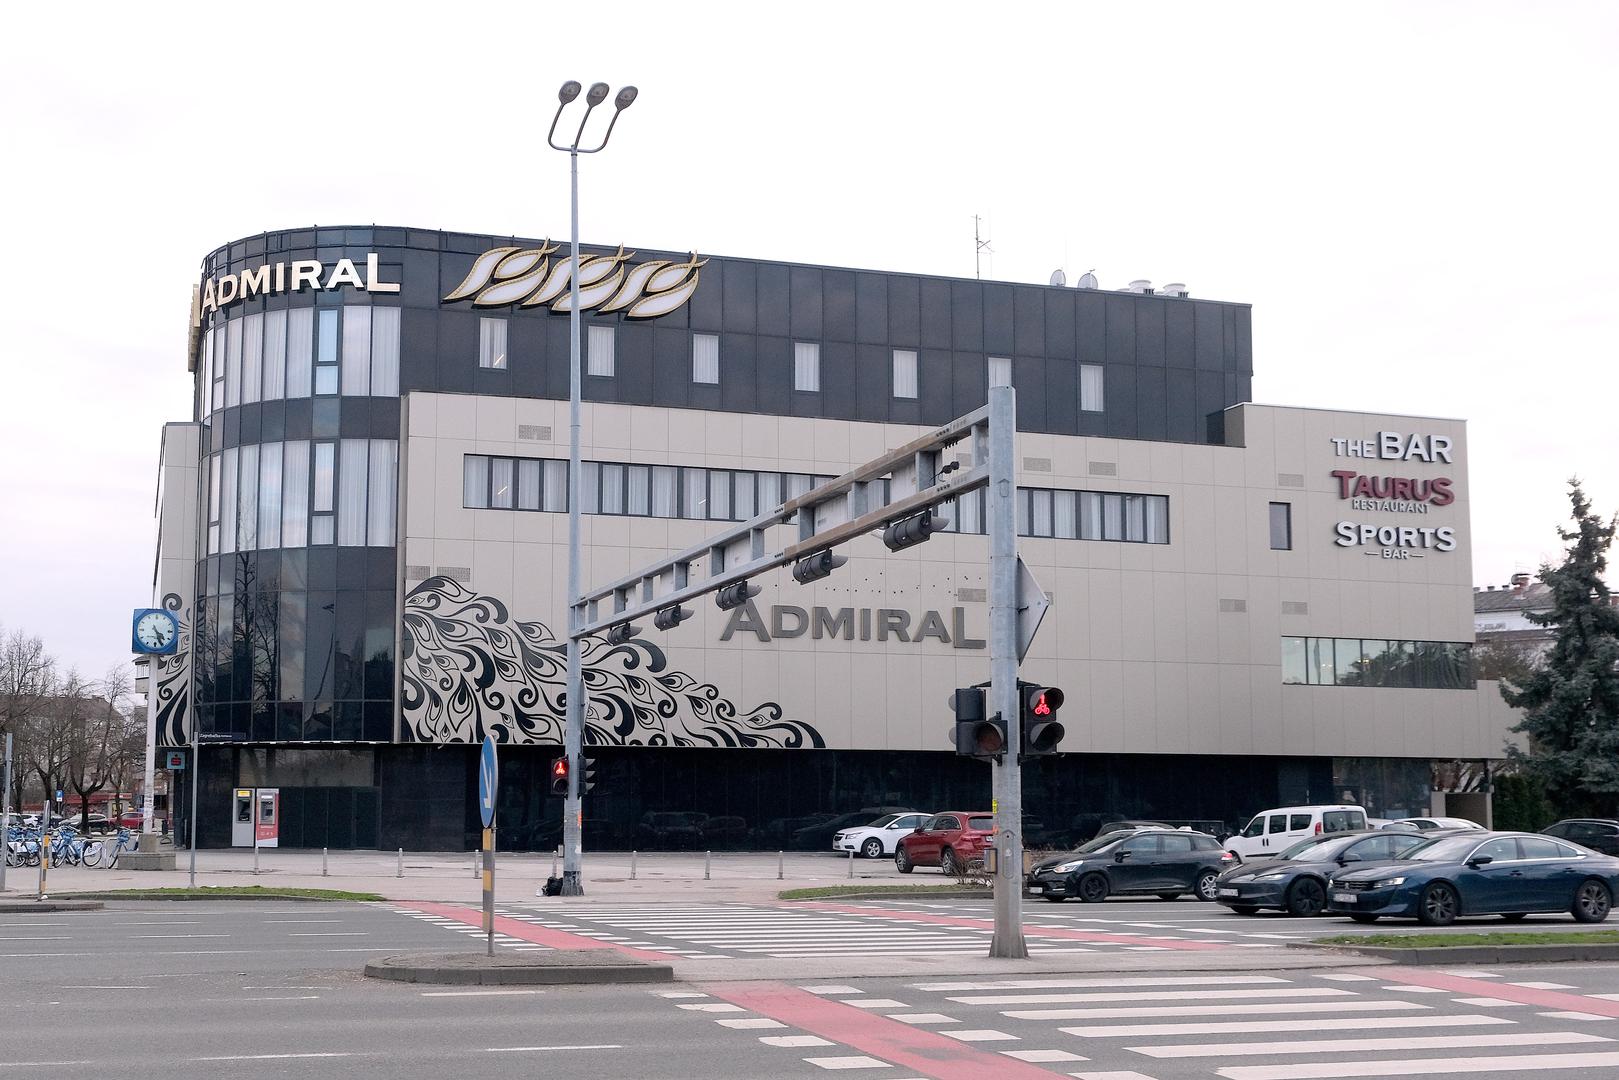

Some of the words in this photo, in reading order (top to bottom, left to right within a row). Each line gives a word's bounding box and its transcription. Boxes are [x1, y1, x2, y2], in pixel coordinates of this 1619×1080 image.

[200, 252, 400, 319] ADMIRAL
[1331, 438, 1375, 459] THE
[1378, 431, 1453, 463] BAR
[1331, 470, 1455, 506] TAURUS
[1352, 499, 1431, 514] RESTAURANT
[1335, 521, 1457, 552] SPORTS
[1382, 548, 1409, 560] BAR
[720, 598, 986, 649] ADMIRAL
